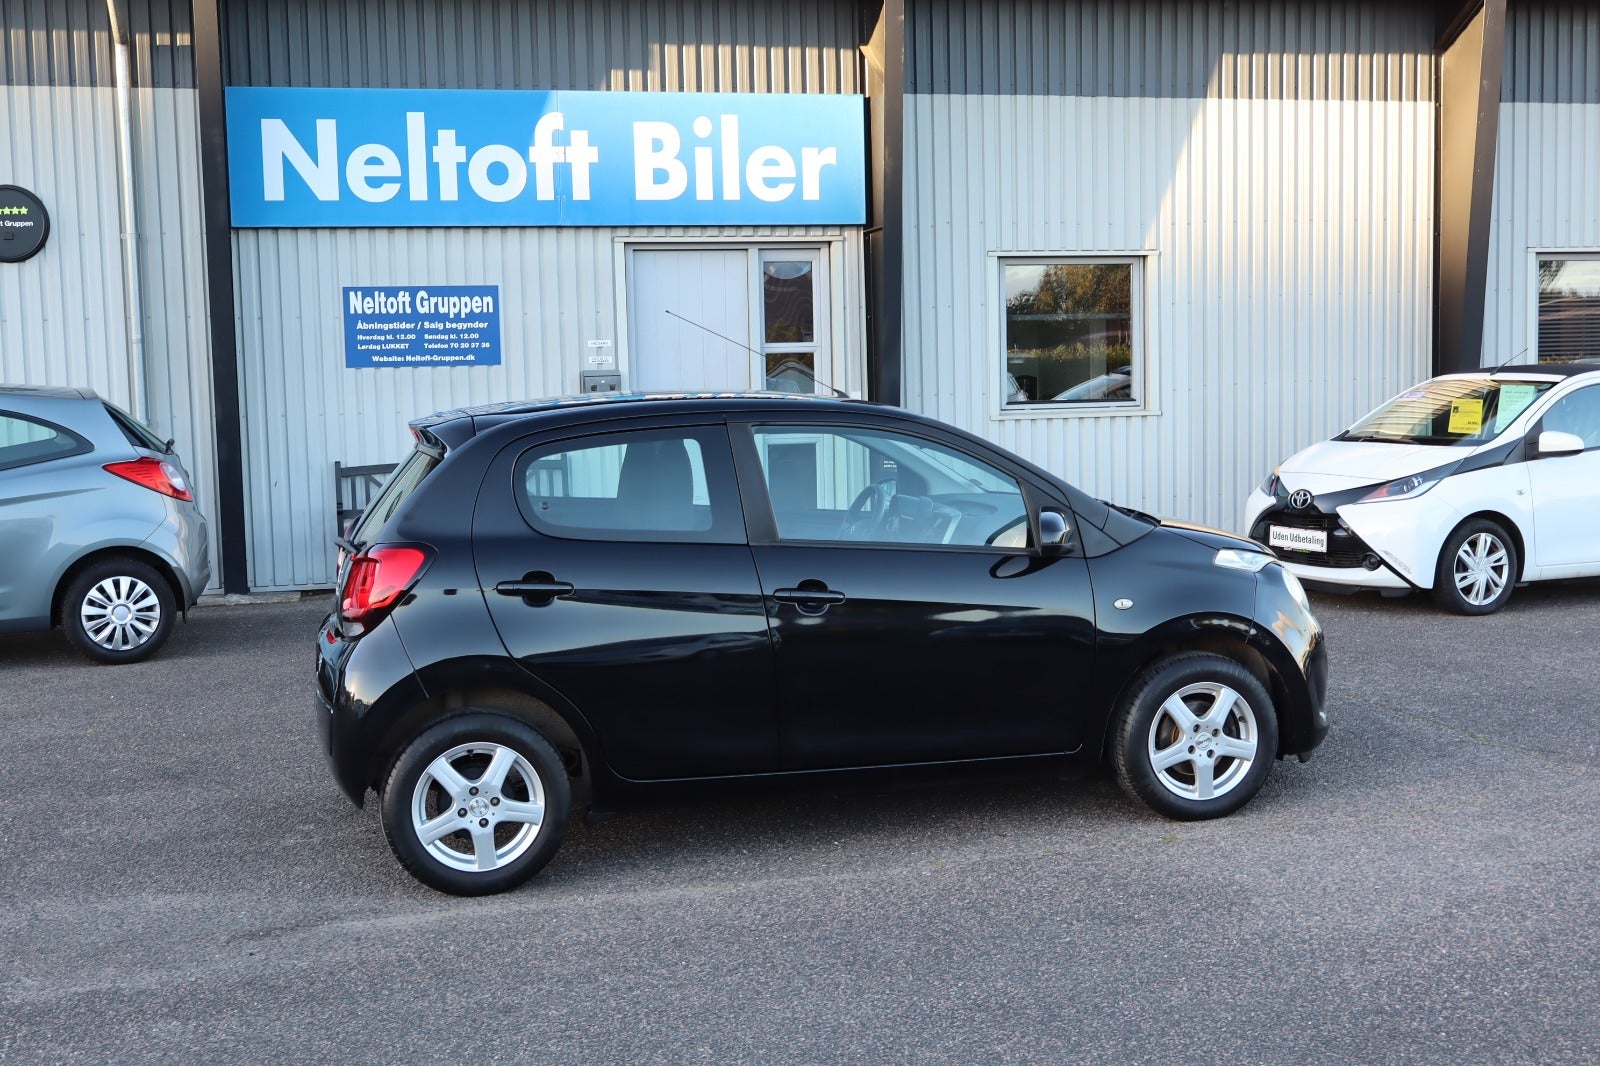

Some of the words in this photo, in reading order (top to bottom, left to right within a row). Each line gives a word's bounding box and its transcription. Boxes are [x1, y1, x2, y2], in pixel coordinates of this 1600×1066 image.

[260, 112, 598, 203] Neltoft
[632, 114, 837, 203] Biler
[4, 220, 34, 228] Gruppen
[349, 290, 411, 314] Neltoft
[415, 290, 493, 318] Gruppen
[356, 320, 415, 330] Åbningstider
[424, 321, 444, 330] Salg
[445, 321, 488, 330] begynder
[1272, 531, 1289, 541] Uden
[1290, 533, 1324, 547] Udbetaling
